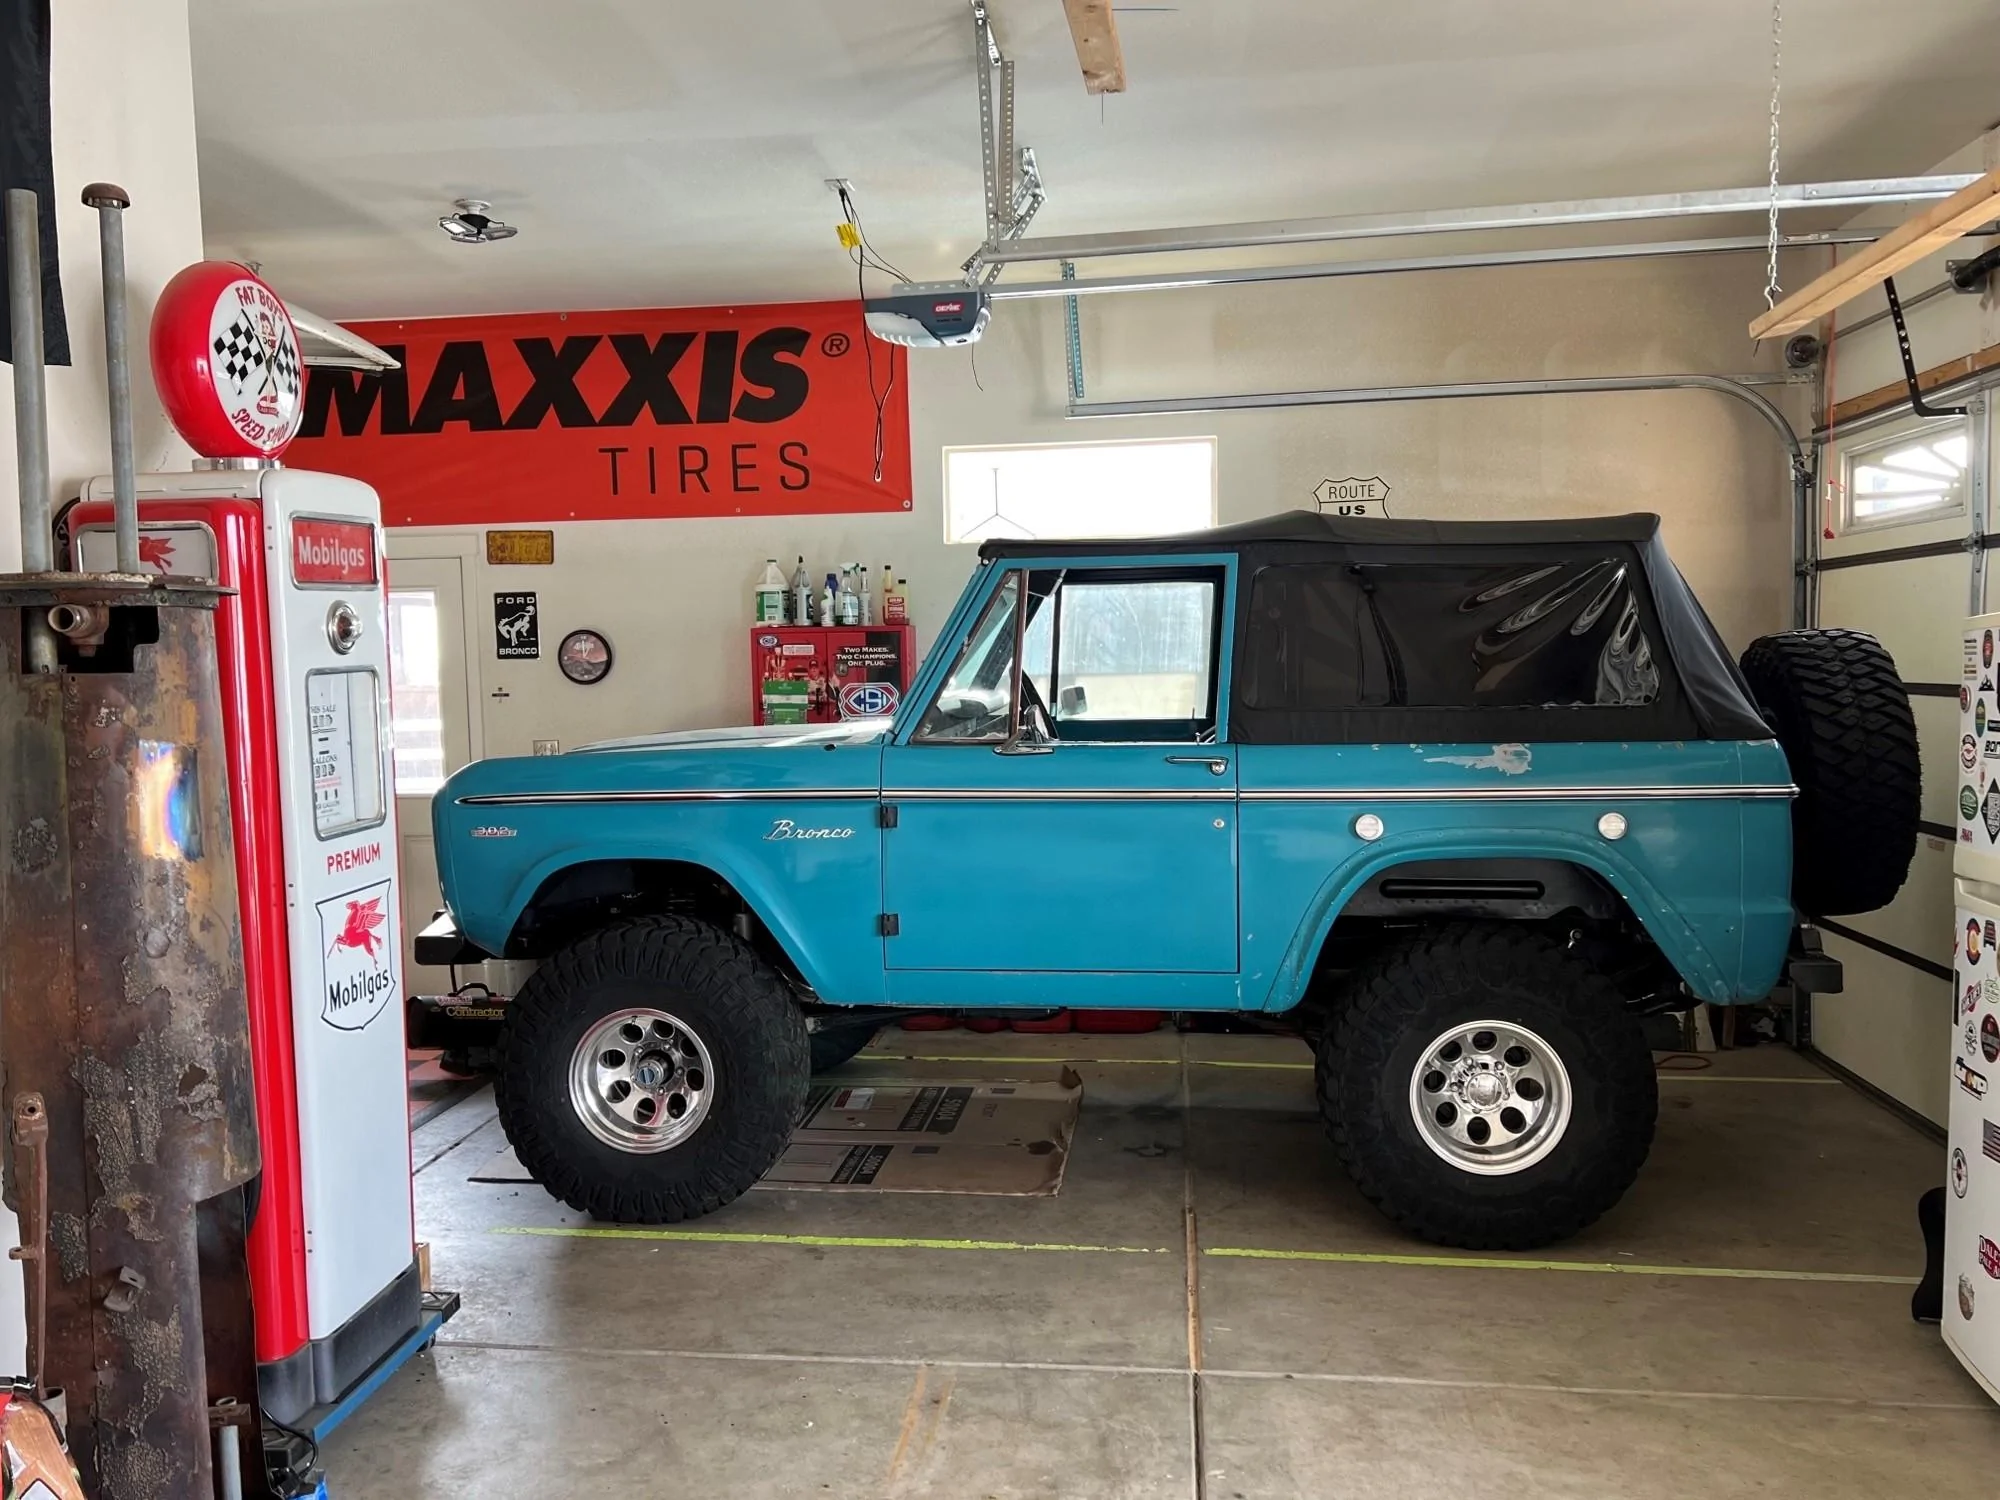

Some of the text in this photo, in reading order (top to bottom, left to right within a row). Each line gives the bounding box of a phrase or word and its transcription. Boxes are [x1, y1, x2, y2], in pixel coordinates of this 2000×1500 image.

[235, 286, 255, 307] FAT
[298, 327, 812, 438] MAXXIS
[232, 408, 290, 444] SPEED SHOP
[598, 441, 811, 496] TIRES
[1328, 484, 1375, 499] ROUTE
[1338, 505, 1366, 516] US
[298, 536, 365, 575] Mobilgas
[497, 596, 536, 605] FORD
[499, 647, 538, 655] BRONCO
[477, 826, 509, 836] 302
[762, 819, 856, 841] Bronco
[327, 842, 381, 875] PREMIUM
[329, 969, 389, 1013] Mobilgas
[446, 1006, 505, 1017] Contractor
